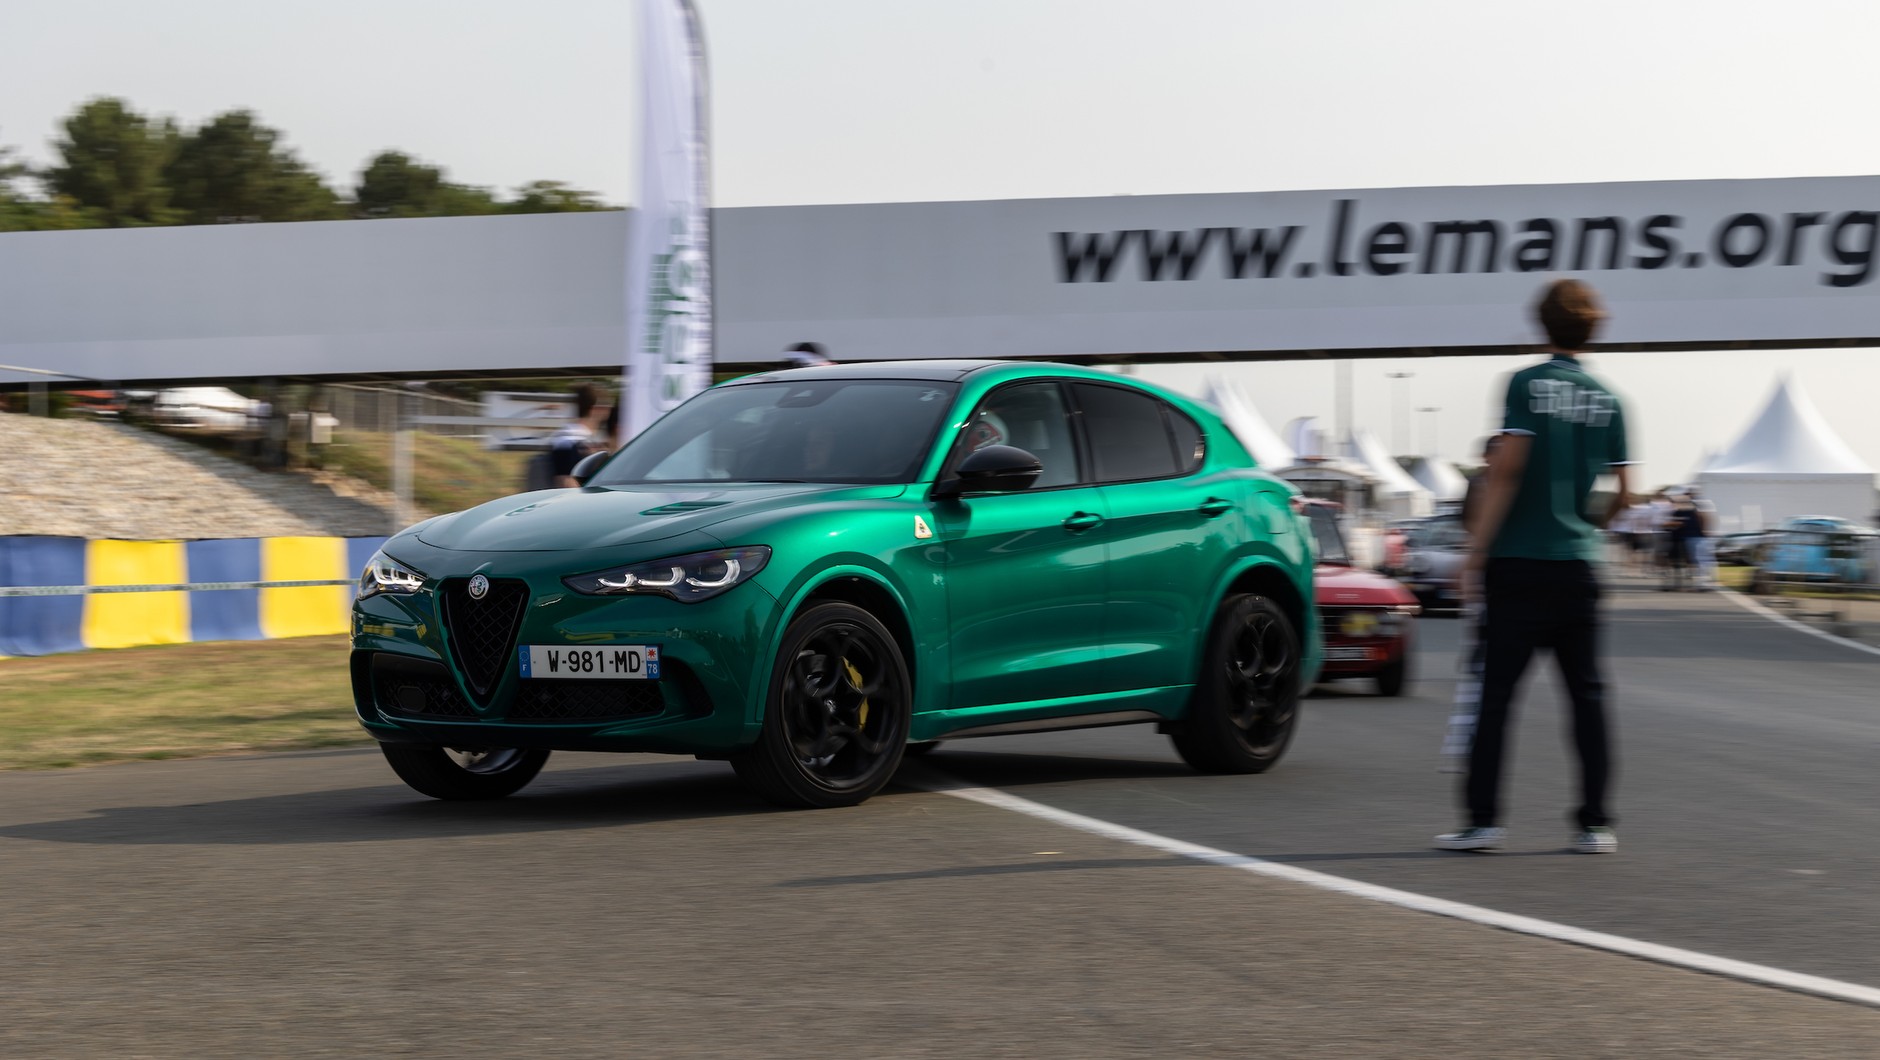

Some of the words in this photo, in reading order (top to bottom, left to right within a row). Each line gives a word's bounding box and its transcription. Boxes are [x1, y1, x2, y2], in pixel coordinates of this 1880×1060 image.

[1050, 199, 1880, 287] www.lemans.org
[547, 650, 641, 673] W-981-MD
[647, 663, 658, 674] 78
